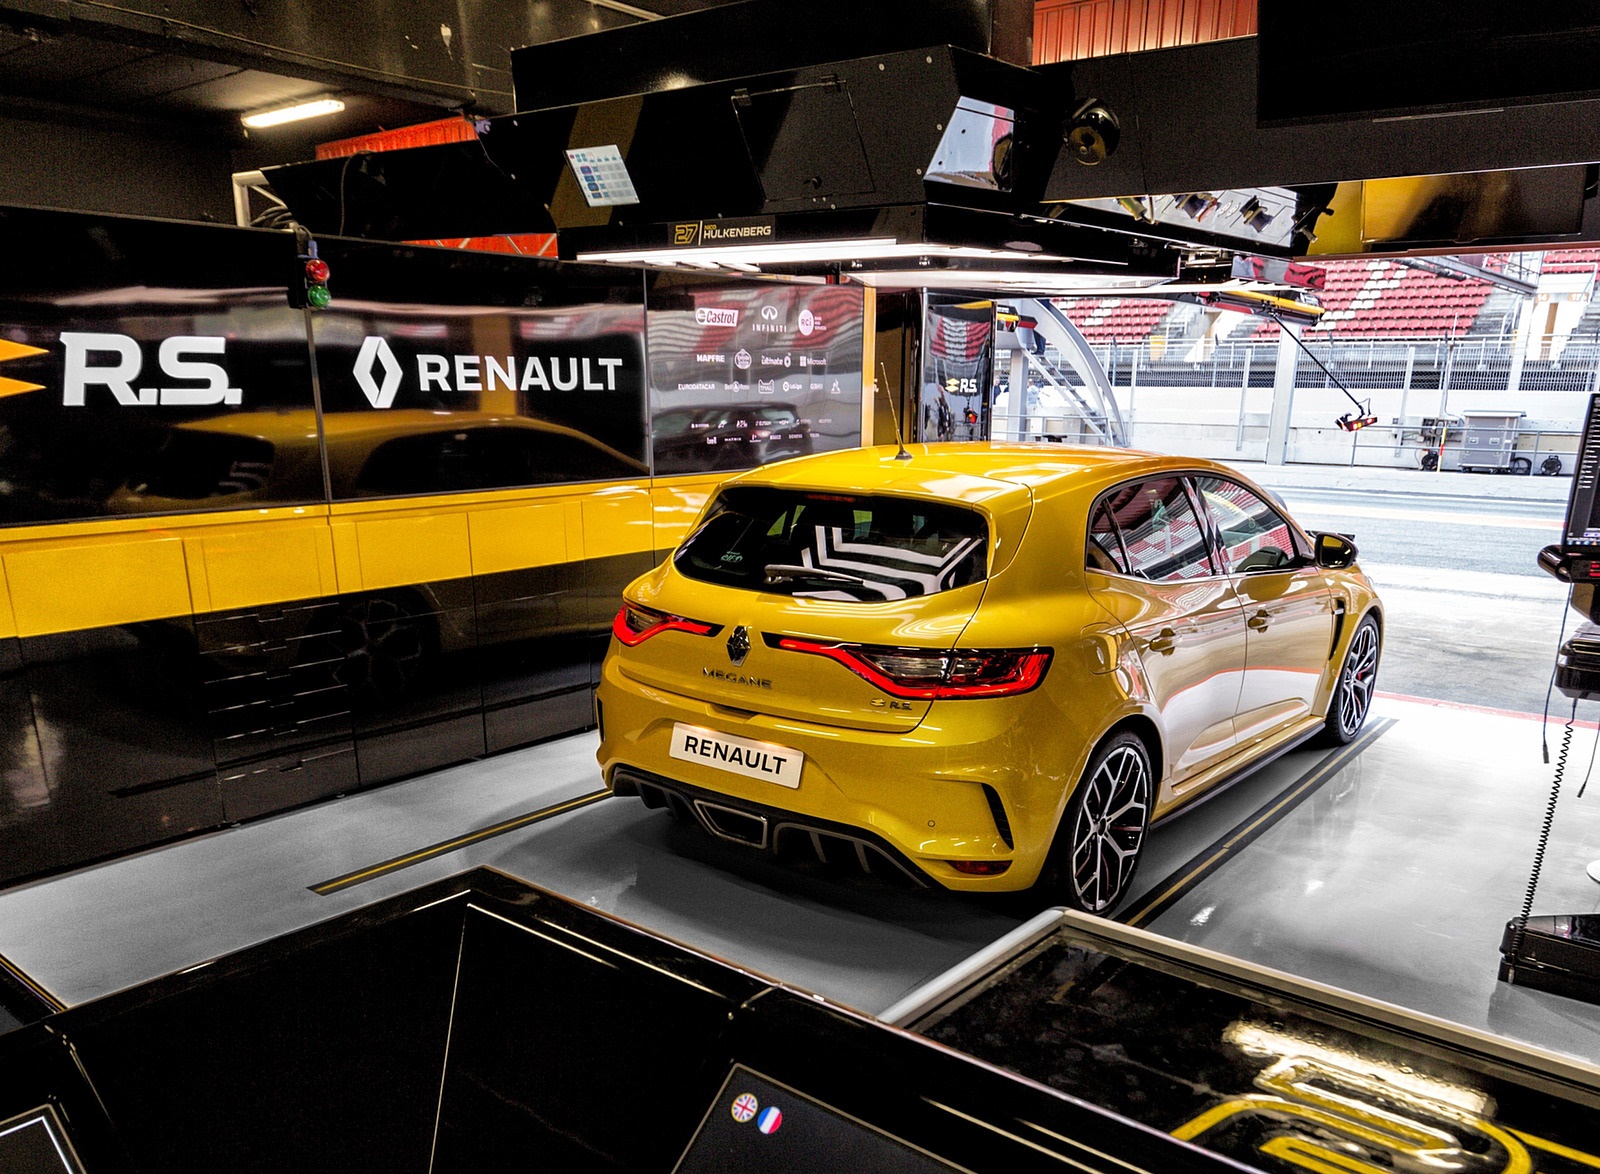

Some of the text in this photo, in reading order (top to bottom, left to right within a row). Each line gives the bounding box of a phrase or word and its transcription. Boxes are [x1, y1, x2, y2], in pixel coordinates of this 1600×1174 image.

[674, 224, 698, 244] 27
[703, 226, 771, 239] HULKENBERG
[706, 310, 735, 324] Castrol
[752, 323, 787, 333] INFINITI
[696, 354, 725, 363] MAPFRE
[59, 332, 243, 406] R.S.
[416, 354, 623, 391] RENAULT
[678, 383, 716, 391] EURODATACAR
[702, 667, 773, 690] MEGANE
[684, 735, 787, 775] RENAULT
